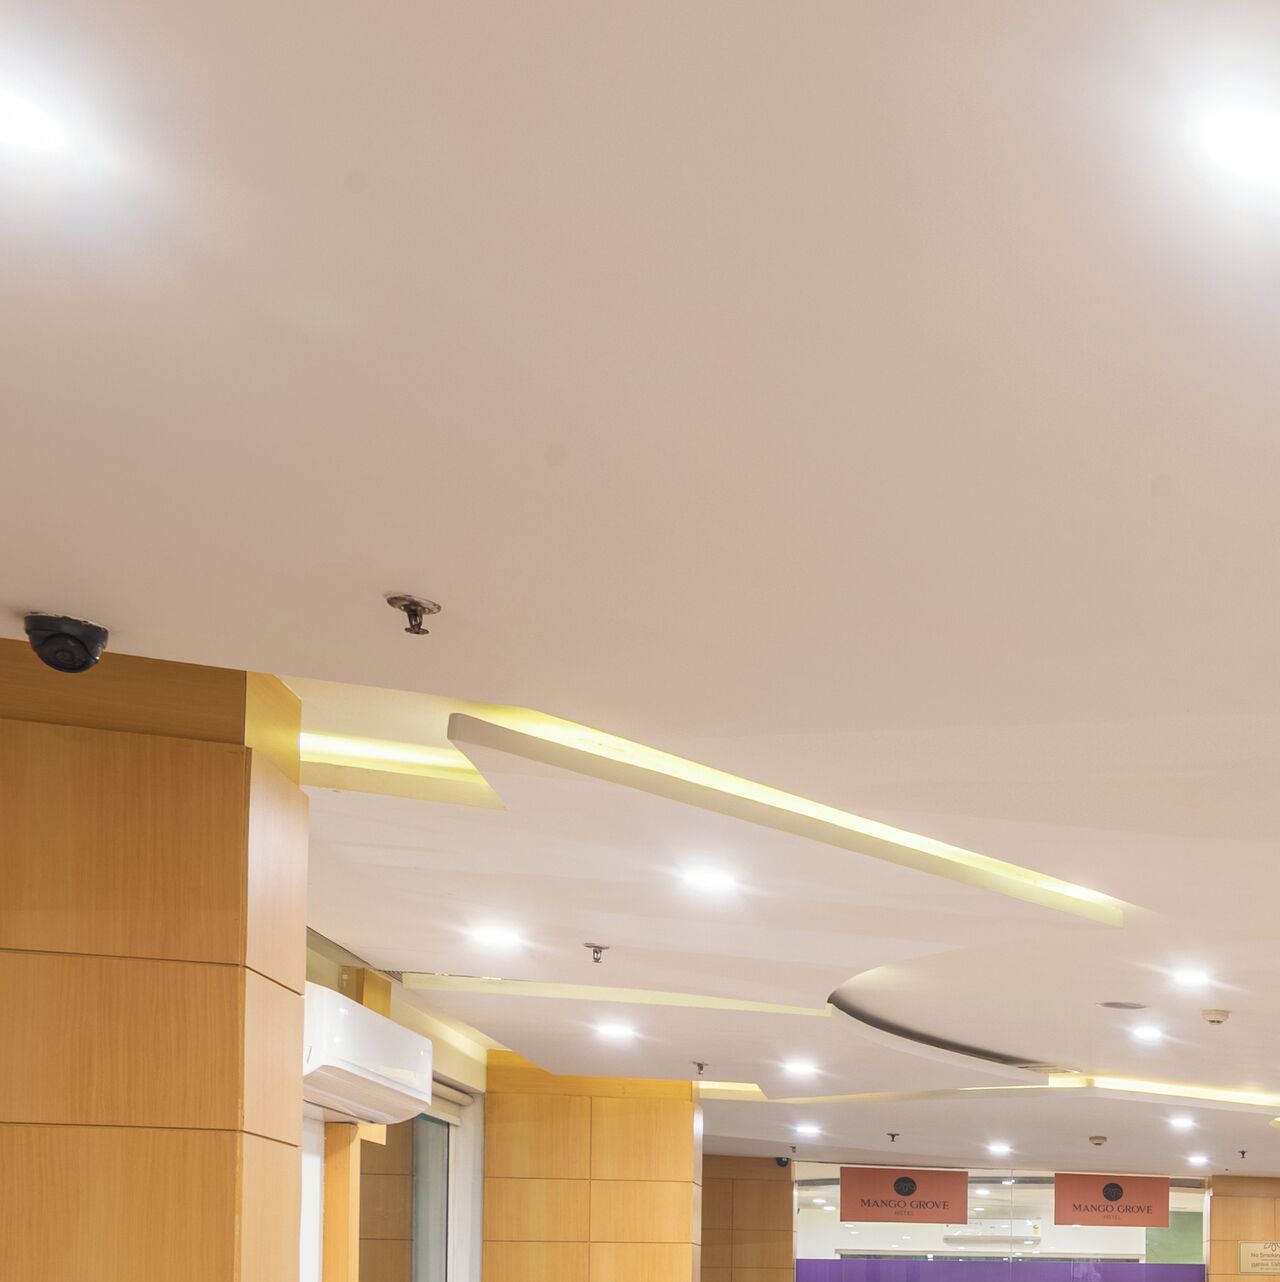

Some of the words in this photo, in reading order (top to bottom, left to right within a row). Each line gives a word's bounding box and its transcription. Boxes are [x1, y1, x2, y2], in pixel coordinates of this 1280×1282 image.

[860, 1198, 907, 1210] MANGO
[909, 1200, 950, 1211] GROVE
[1072, 1203, 1115, 1214] MANGO
[1117, 1204, 1153, 1215] GROVE
